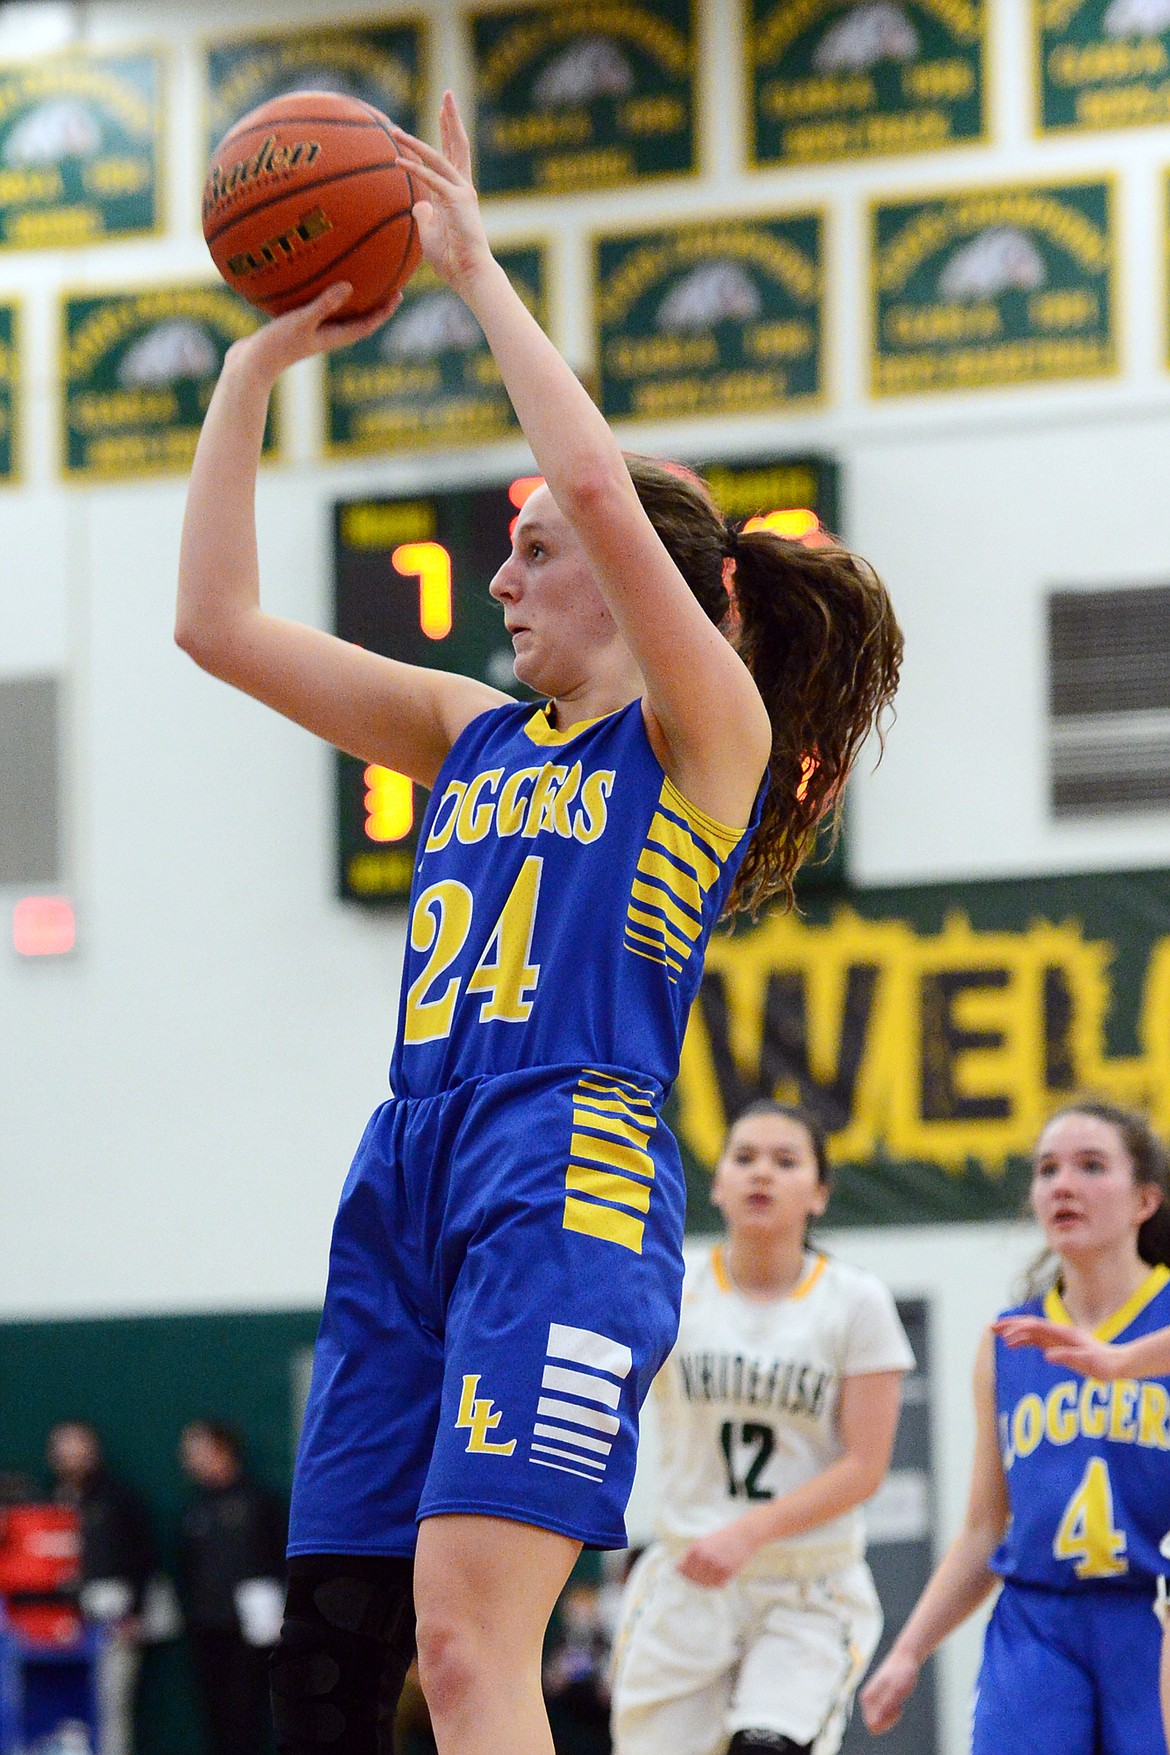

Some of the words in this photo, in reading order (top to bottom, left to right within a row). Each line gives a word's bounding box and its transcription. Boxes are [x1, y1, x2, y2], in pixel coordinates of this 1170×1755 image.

[227, 204, 333, 277] ELITE
[392, 541, 452, 640] 7
[418, 759, 617, 872] OGGERS
[404, 855, 544, 1046] 24
[721, 1420, 776, 1500] 12
[1053, 1455, 1129, 1579] 4
